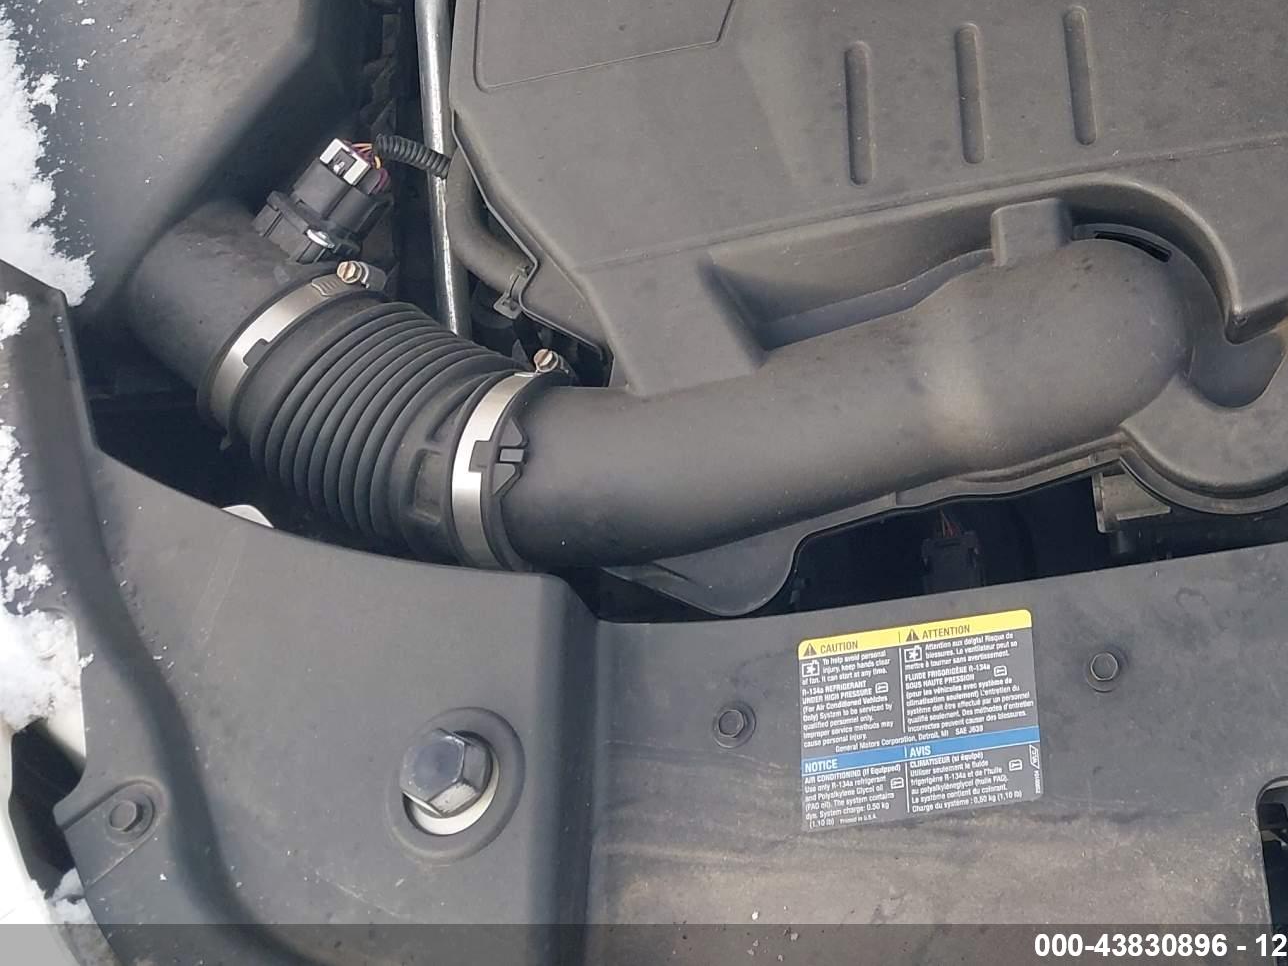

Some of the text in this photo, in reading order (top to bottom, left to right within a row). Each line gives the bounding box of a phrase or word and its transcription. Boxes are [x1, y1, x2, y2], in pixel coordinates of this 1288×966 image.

[922, 625, 970, 640] ATTENTION
[820, 641, 858, 654] CAUTION
[910, 746, 932, 758] AVIS
[804, 759, 838, 772] NOTICE
